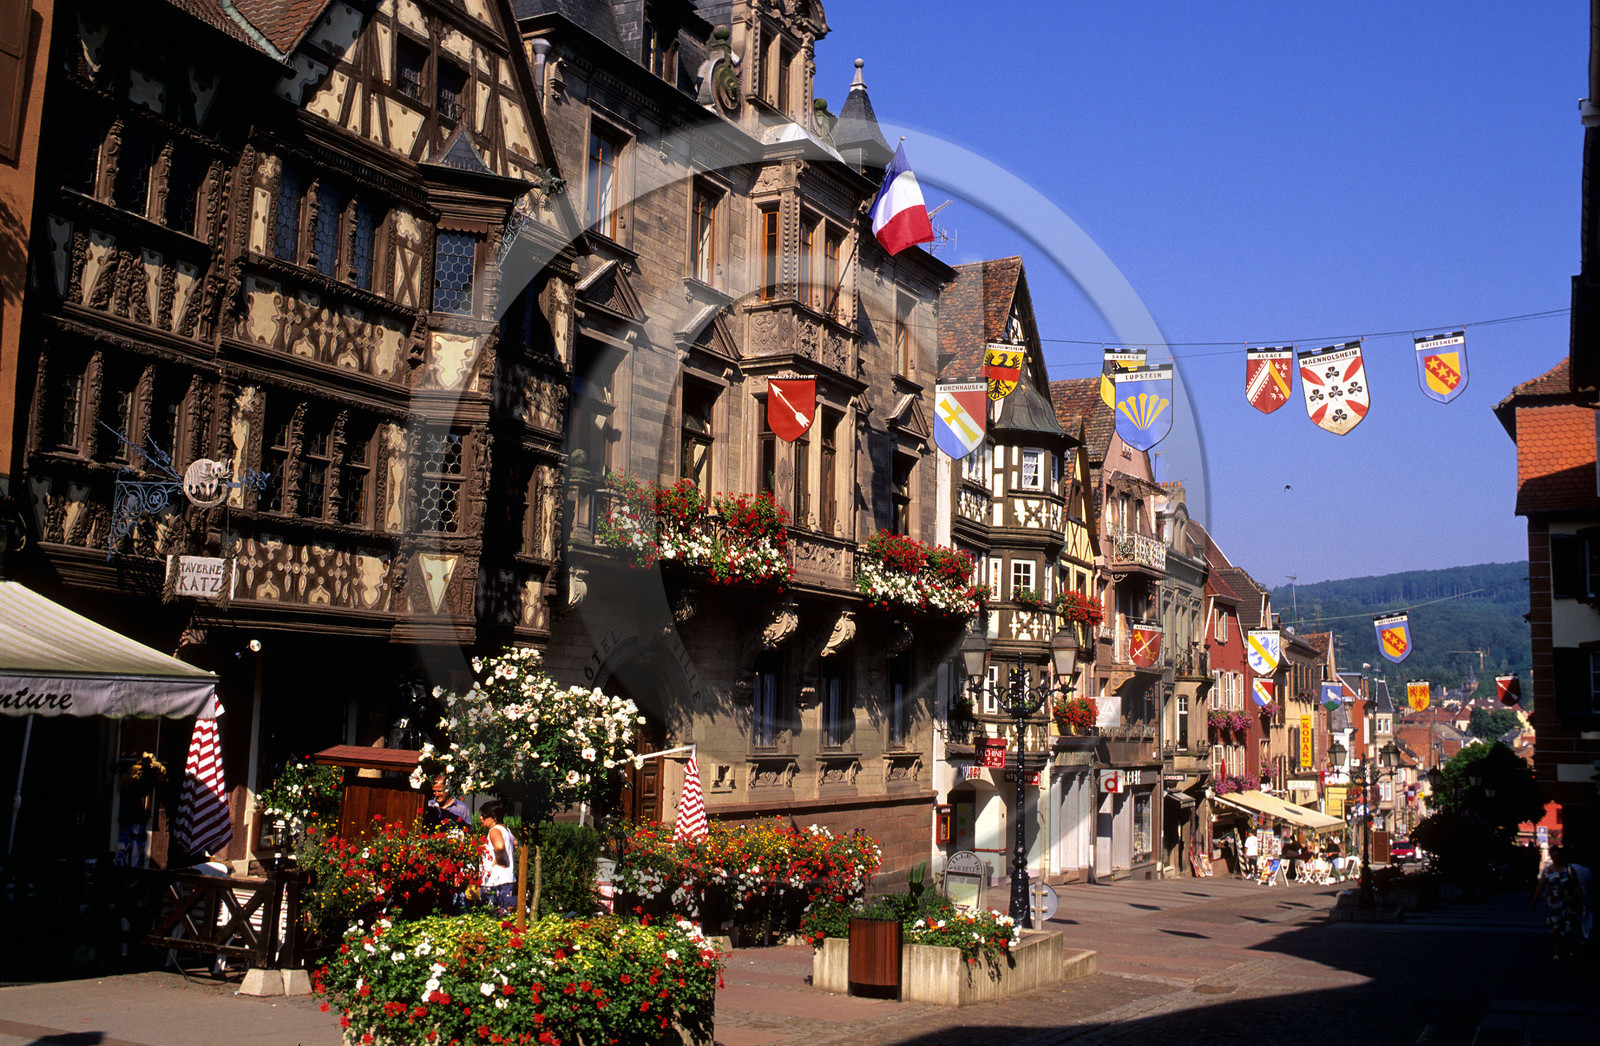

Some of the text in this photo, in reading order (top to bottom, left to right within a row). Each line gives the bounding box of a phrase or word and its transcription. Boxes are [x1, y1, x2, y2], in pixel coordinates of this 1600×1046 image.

[1302, 350, 1358, 366] MAENNOLSHEIM
[180, 562, 222, 575] TAVERNE
[179, 575, 220, 592] KATZ
[580, 630, 620, 689] OTEL
[1302, 722, 1310, 758] KODAK
